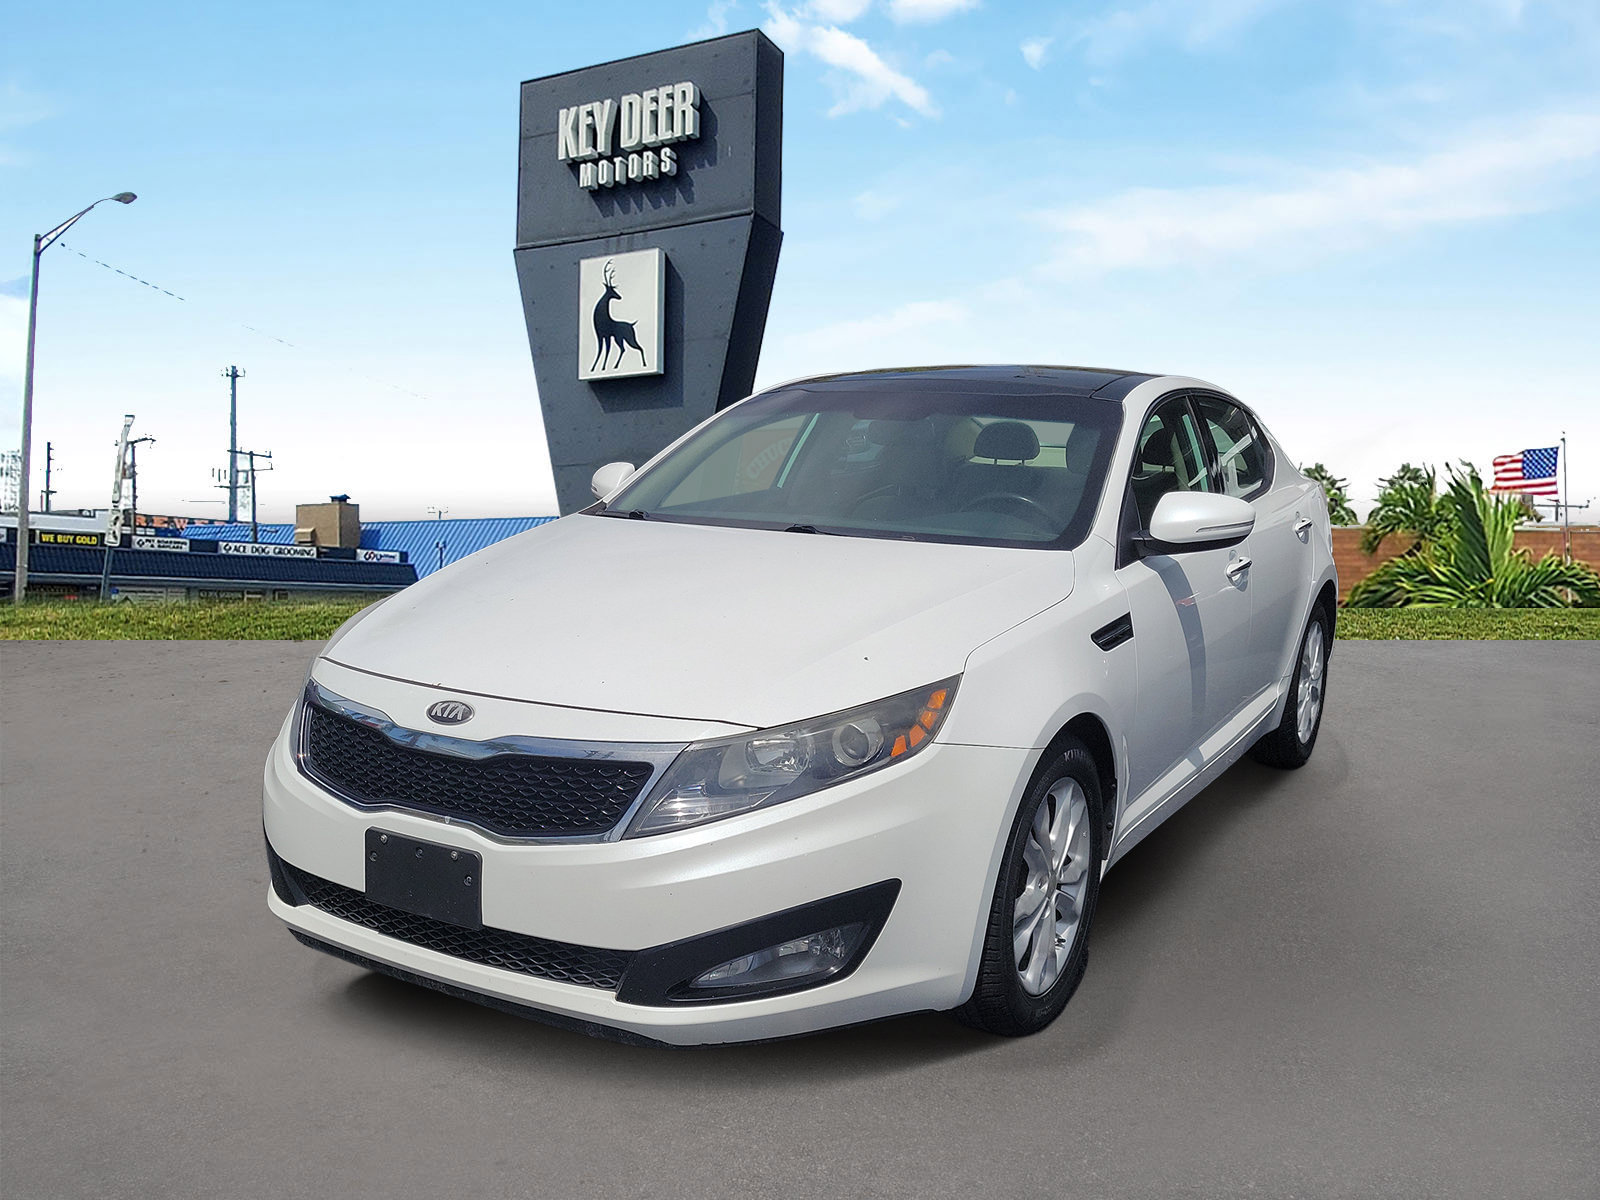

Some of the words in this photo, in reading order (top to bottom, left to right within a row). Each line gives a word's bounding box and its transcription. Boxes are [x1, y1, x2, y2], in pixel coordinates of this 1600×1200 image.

[558, 98, 617, 161] KEY
[620, 81, 700, 152] DEER
[579, 147, 677, 190] MOTORS
[41, 533, 55, 543] WE
[57, 534, 74, 544] BUY
[76, 535, 97, 545] GOLD
[232, 544, 247, 553] ACE
[251, 545, 270, 555] DOG
[273, 547, 315, 557] GROOMING
[431, 702, 466, 721] KIA
